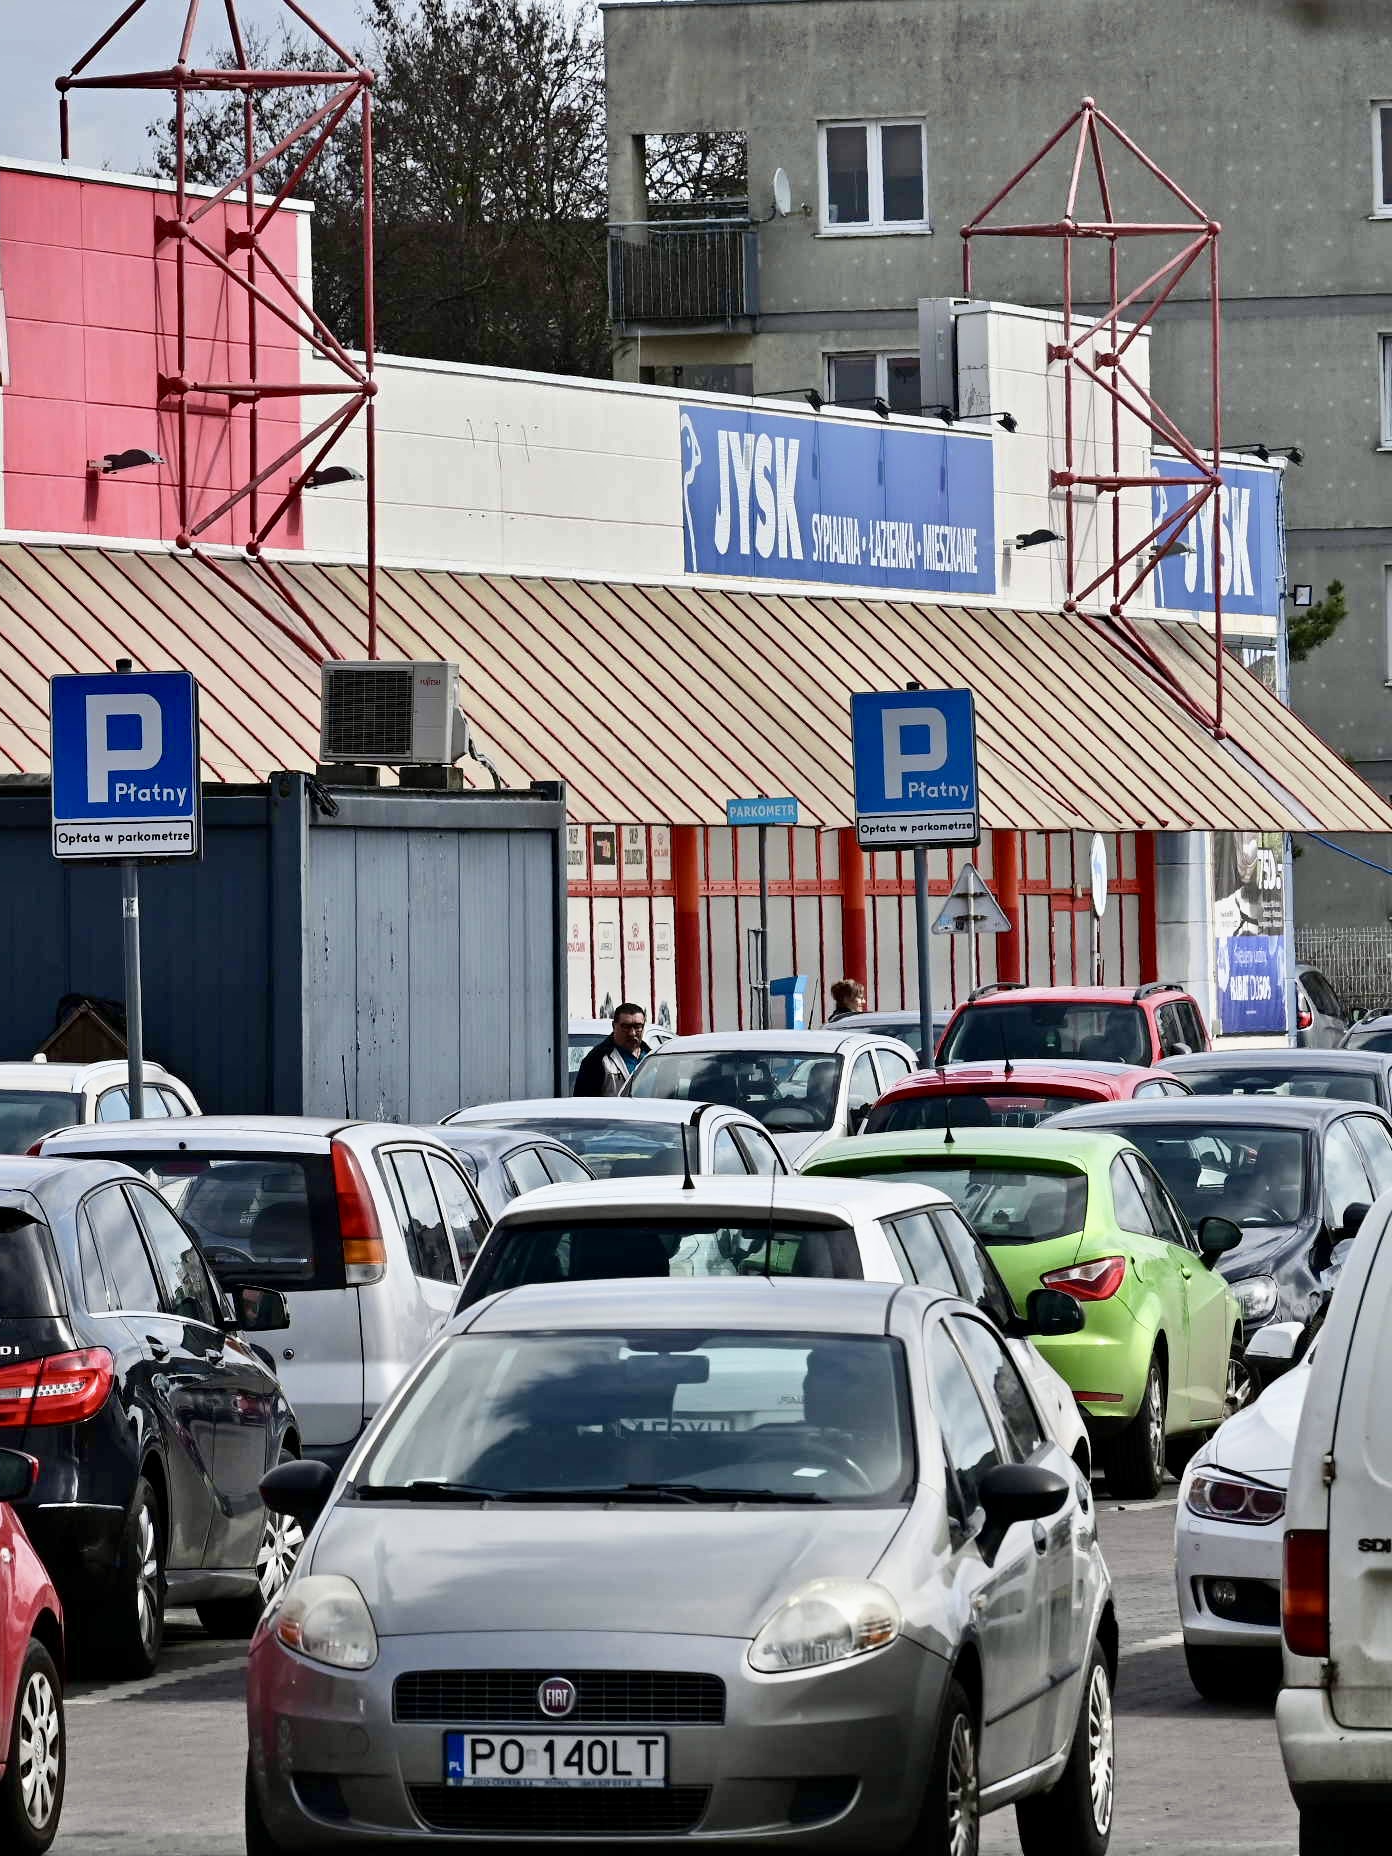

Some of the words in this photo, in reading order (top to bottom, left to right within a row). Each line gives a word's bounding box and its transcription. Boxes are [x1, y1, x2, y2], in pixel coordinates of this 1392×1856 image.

[715, 430, 803, 560] JYSK
[812, 513, 861, 566] SYPIALNIA
[869, 520, 915, 569] ŁAZIENKA
[923, 524, 977, 574] MIESZKANIE
[1184, 484, 1254, 596] JYSK
[86, 693, 163, 803] P
[882, 707, 948, 800] P
[115, 782, 188, 807] Płatny
[908, 781, 969, 801] Płatny
[729, 804, 795, 818] PARKOMETR
[58, 832, 100, 846] Opłata
[104, 833, 113, 842] w
[118, 831, 190, 844] parkometrze
[860, 824, 897, 835] Opłata
[900, 824, 908, 832] w
[911, 821, 973, 833] parkometrze
[1358, 1537, 1392, 1554] SDI
[546, 1688, 569, 1707] FIAT
[448, 1761, 462, 1772] PL
[470, 1738, 525, 1776] PO
[543, 1738, 659, 1777] 140LT
